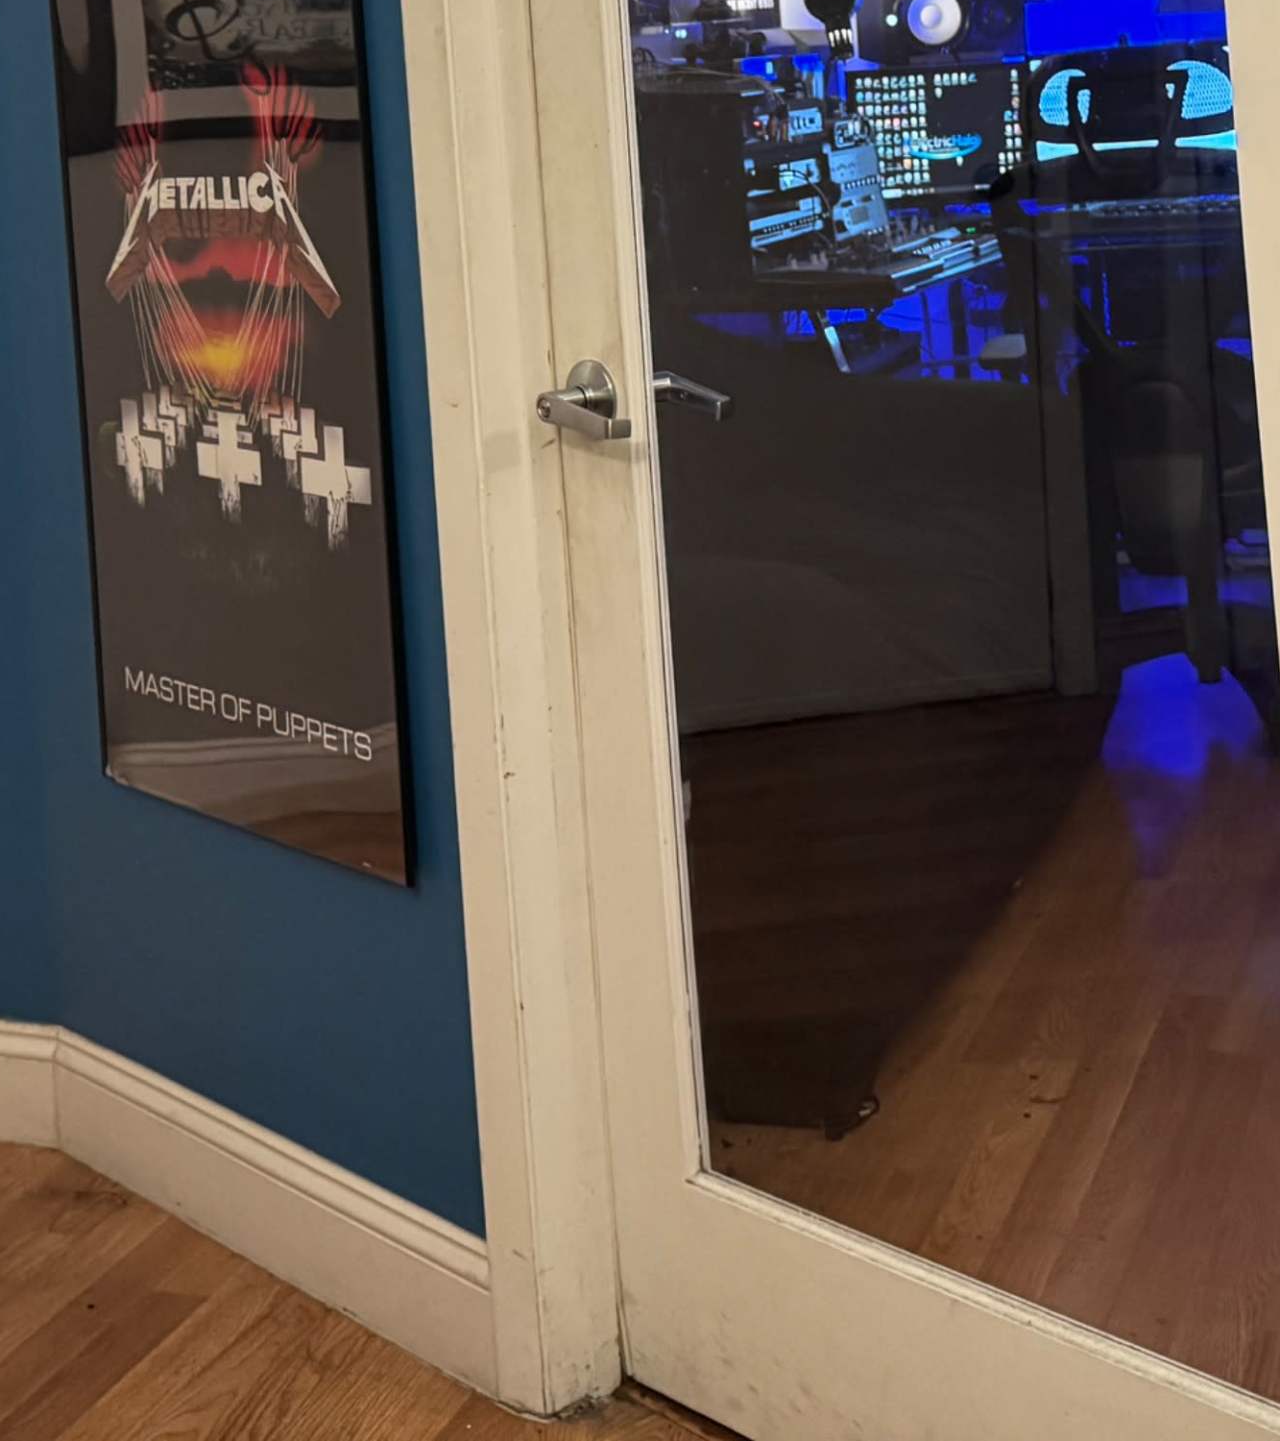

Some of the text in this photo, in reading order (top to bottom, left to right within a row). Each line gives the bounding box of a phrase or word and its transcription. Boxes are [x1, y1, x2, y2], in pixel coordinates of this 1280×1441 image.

[105, 160, 340, 298] METALLICA
[124, 665, 373, 762] MASTER OF PUPPETS
